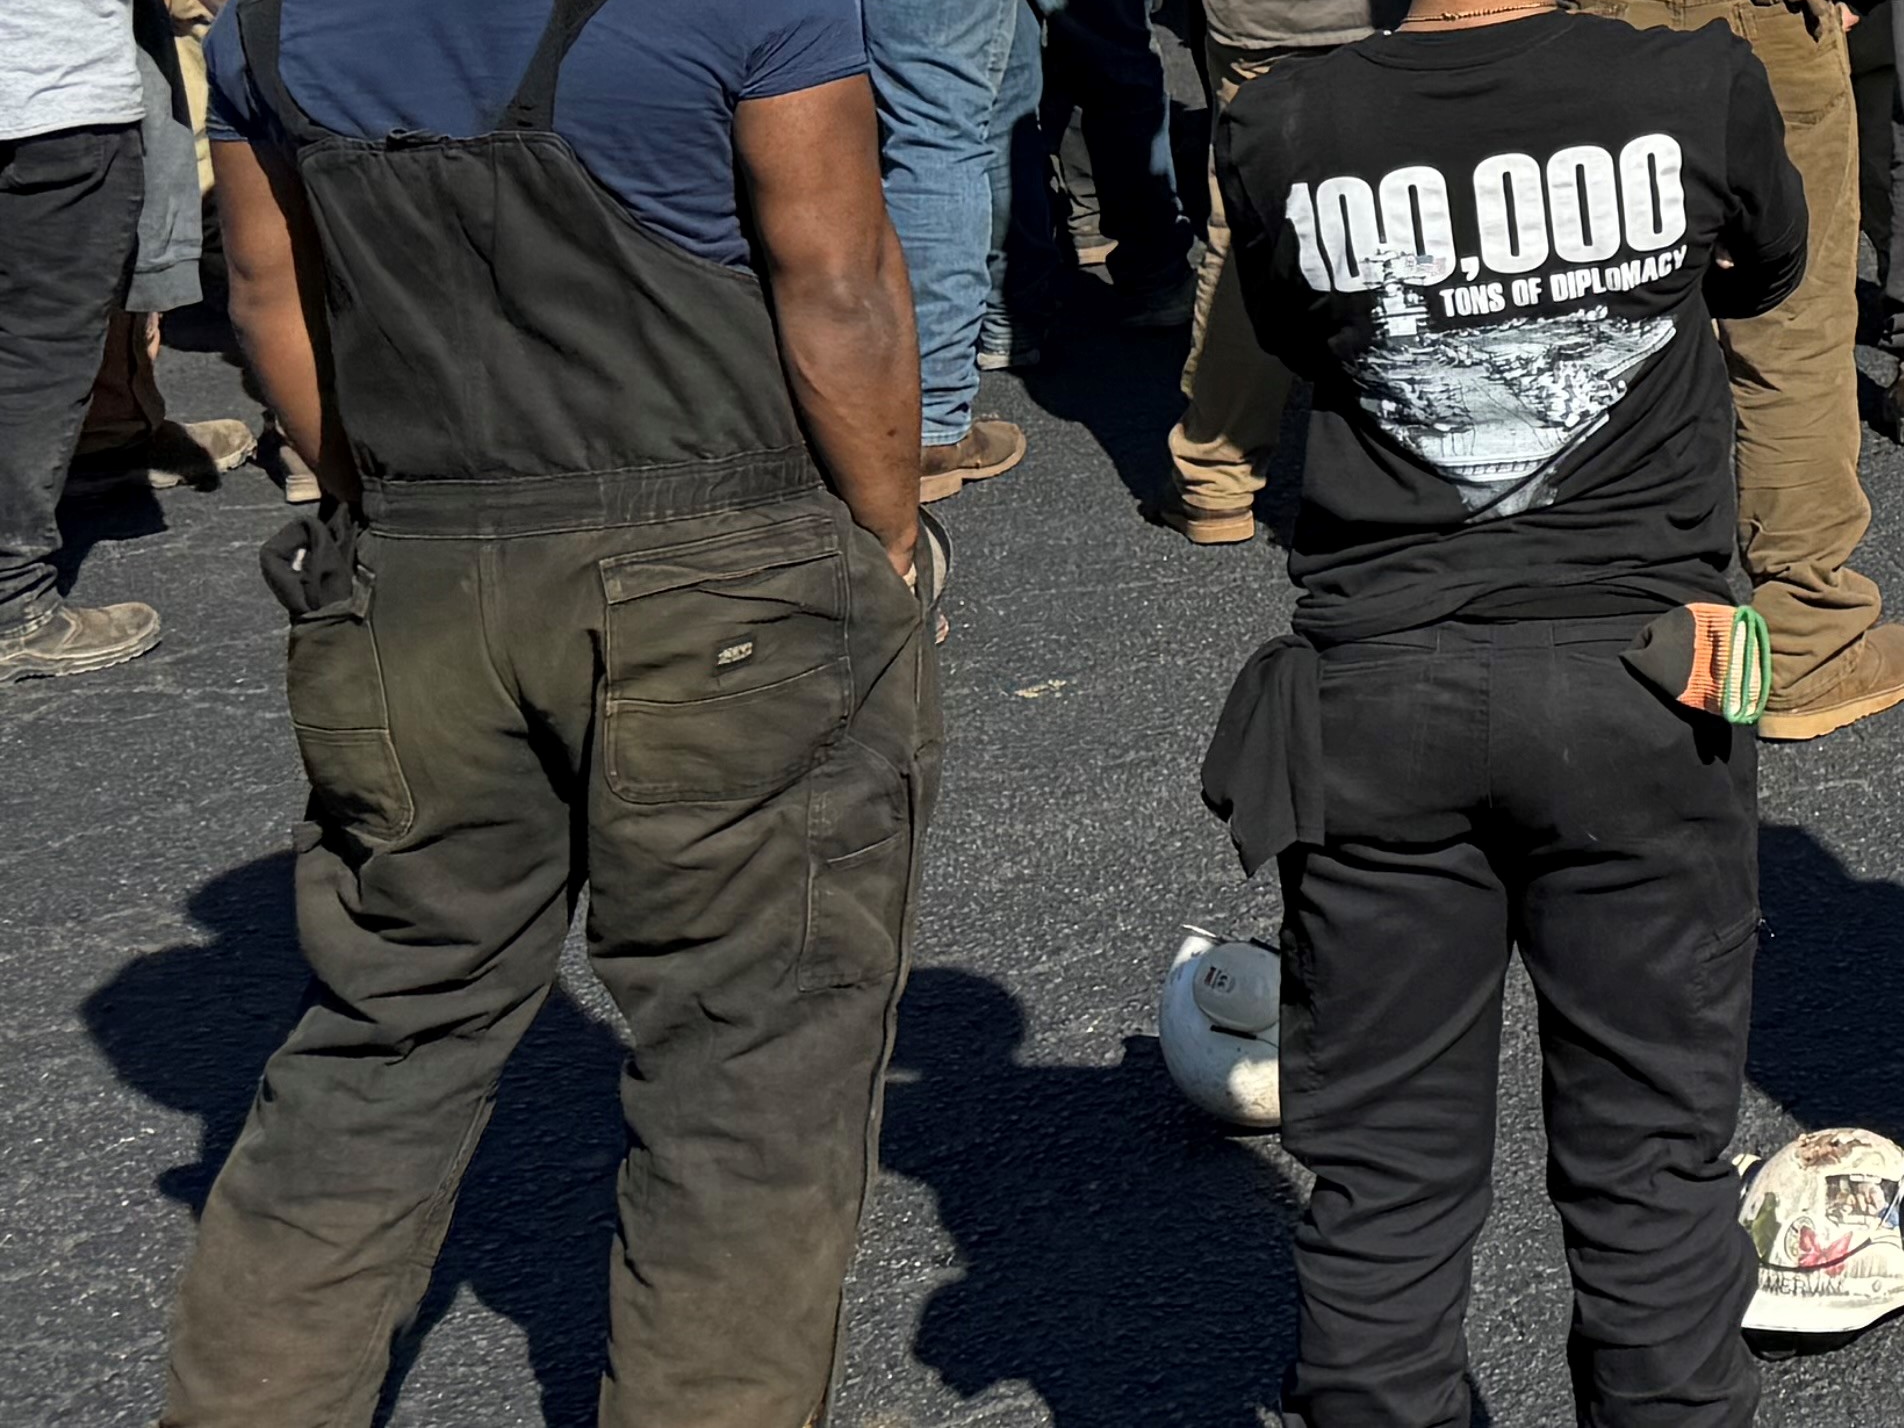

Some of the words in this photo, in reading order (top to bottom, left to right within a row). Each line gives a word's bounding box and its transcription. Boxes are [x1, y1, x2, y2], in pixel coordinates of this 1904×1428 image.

[1285, 133, 1687, 293] 100,000
[1438, 282, 1507, 319] TONS
[1512, 277, 1543, 308] OF
[1550, 245, 1689, 304] DIPLOMACY
